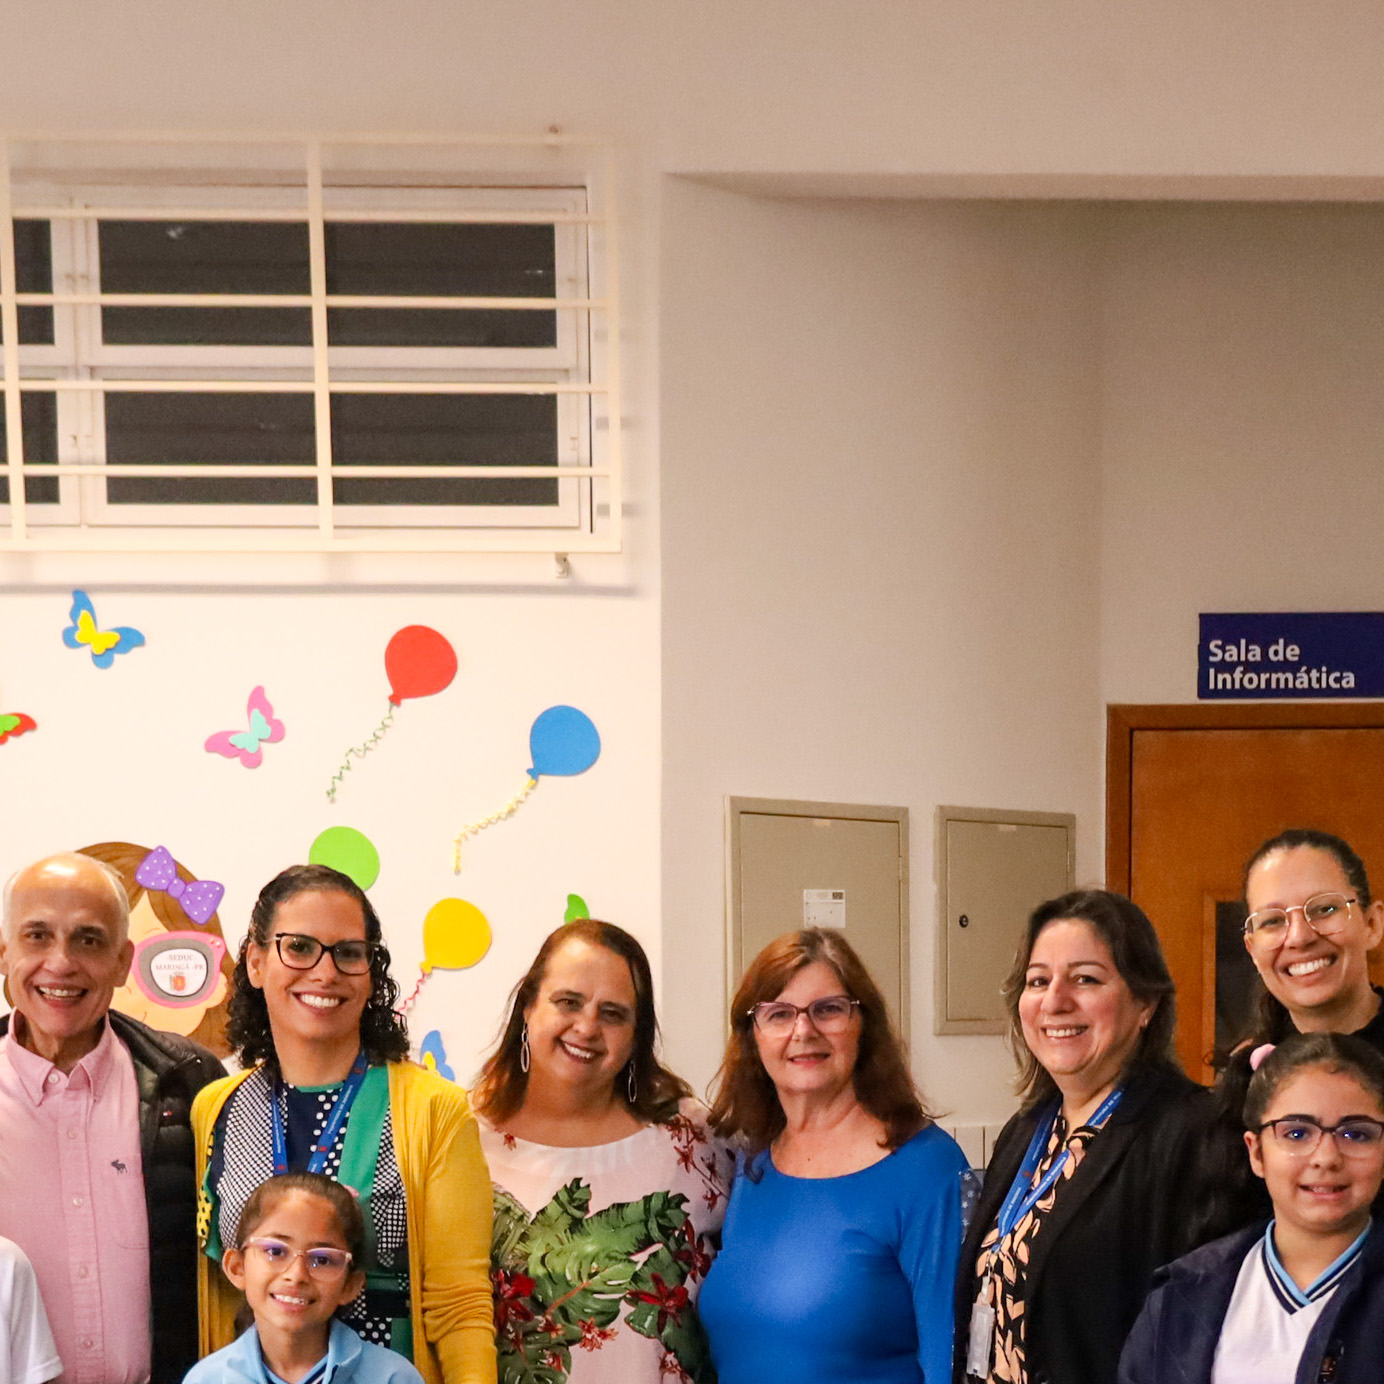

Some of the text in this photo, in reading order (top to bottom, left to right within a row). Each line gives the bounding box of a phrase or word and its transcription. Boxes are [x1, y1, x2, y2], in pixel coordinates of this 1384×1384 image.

[1208, 639, 1301, 662] Sala de
[1208, 666, 1355, 690] Informática
